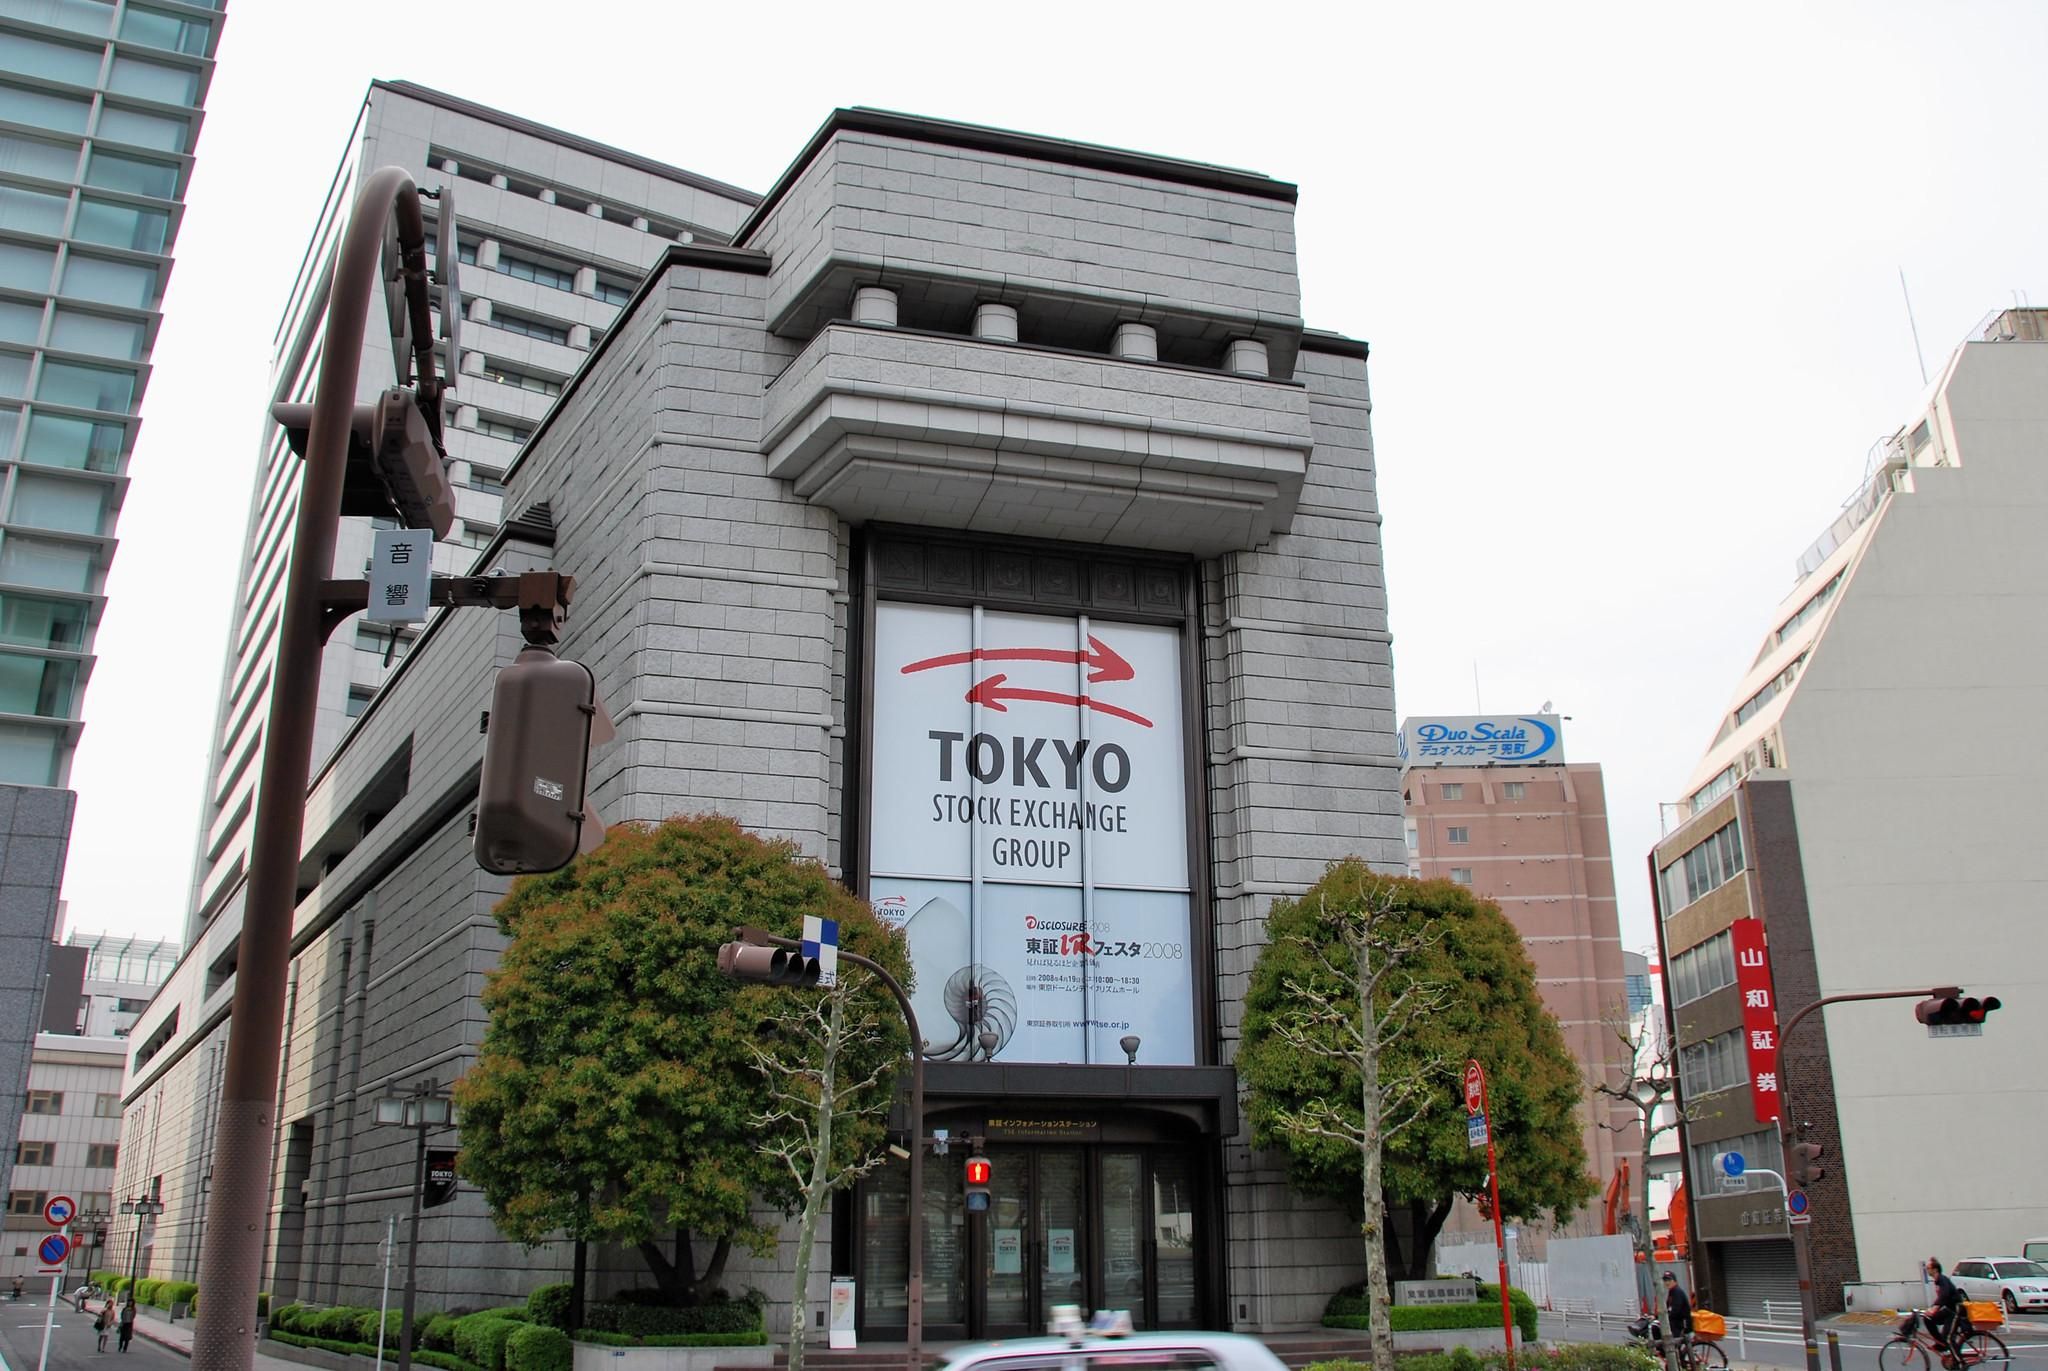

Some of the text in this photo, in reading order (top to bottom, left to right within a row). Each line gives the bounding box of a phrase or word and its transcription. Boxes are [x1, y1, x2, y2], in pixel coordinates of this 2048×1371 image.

[386, 542, 413, 606] 音響
[1418, 722, 1526, 742] Duo Scala
[928, 730, 1131, 793] TOKYO
[932, 793, 1127, 833] STOCK EXCHANGE
[992, 837, 1071, 869] GROUP
[1073, 1020, 1130, 1030] wwwtse.or.jp
[1740, 948, 1778, 1092] 山和証券
